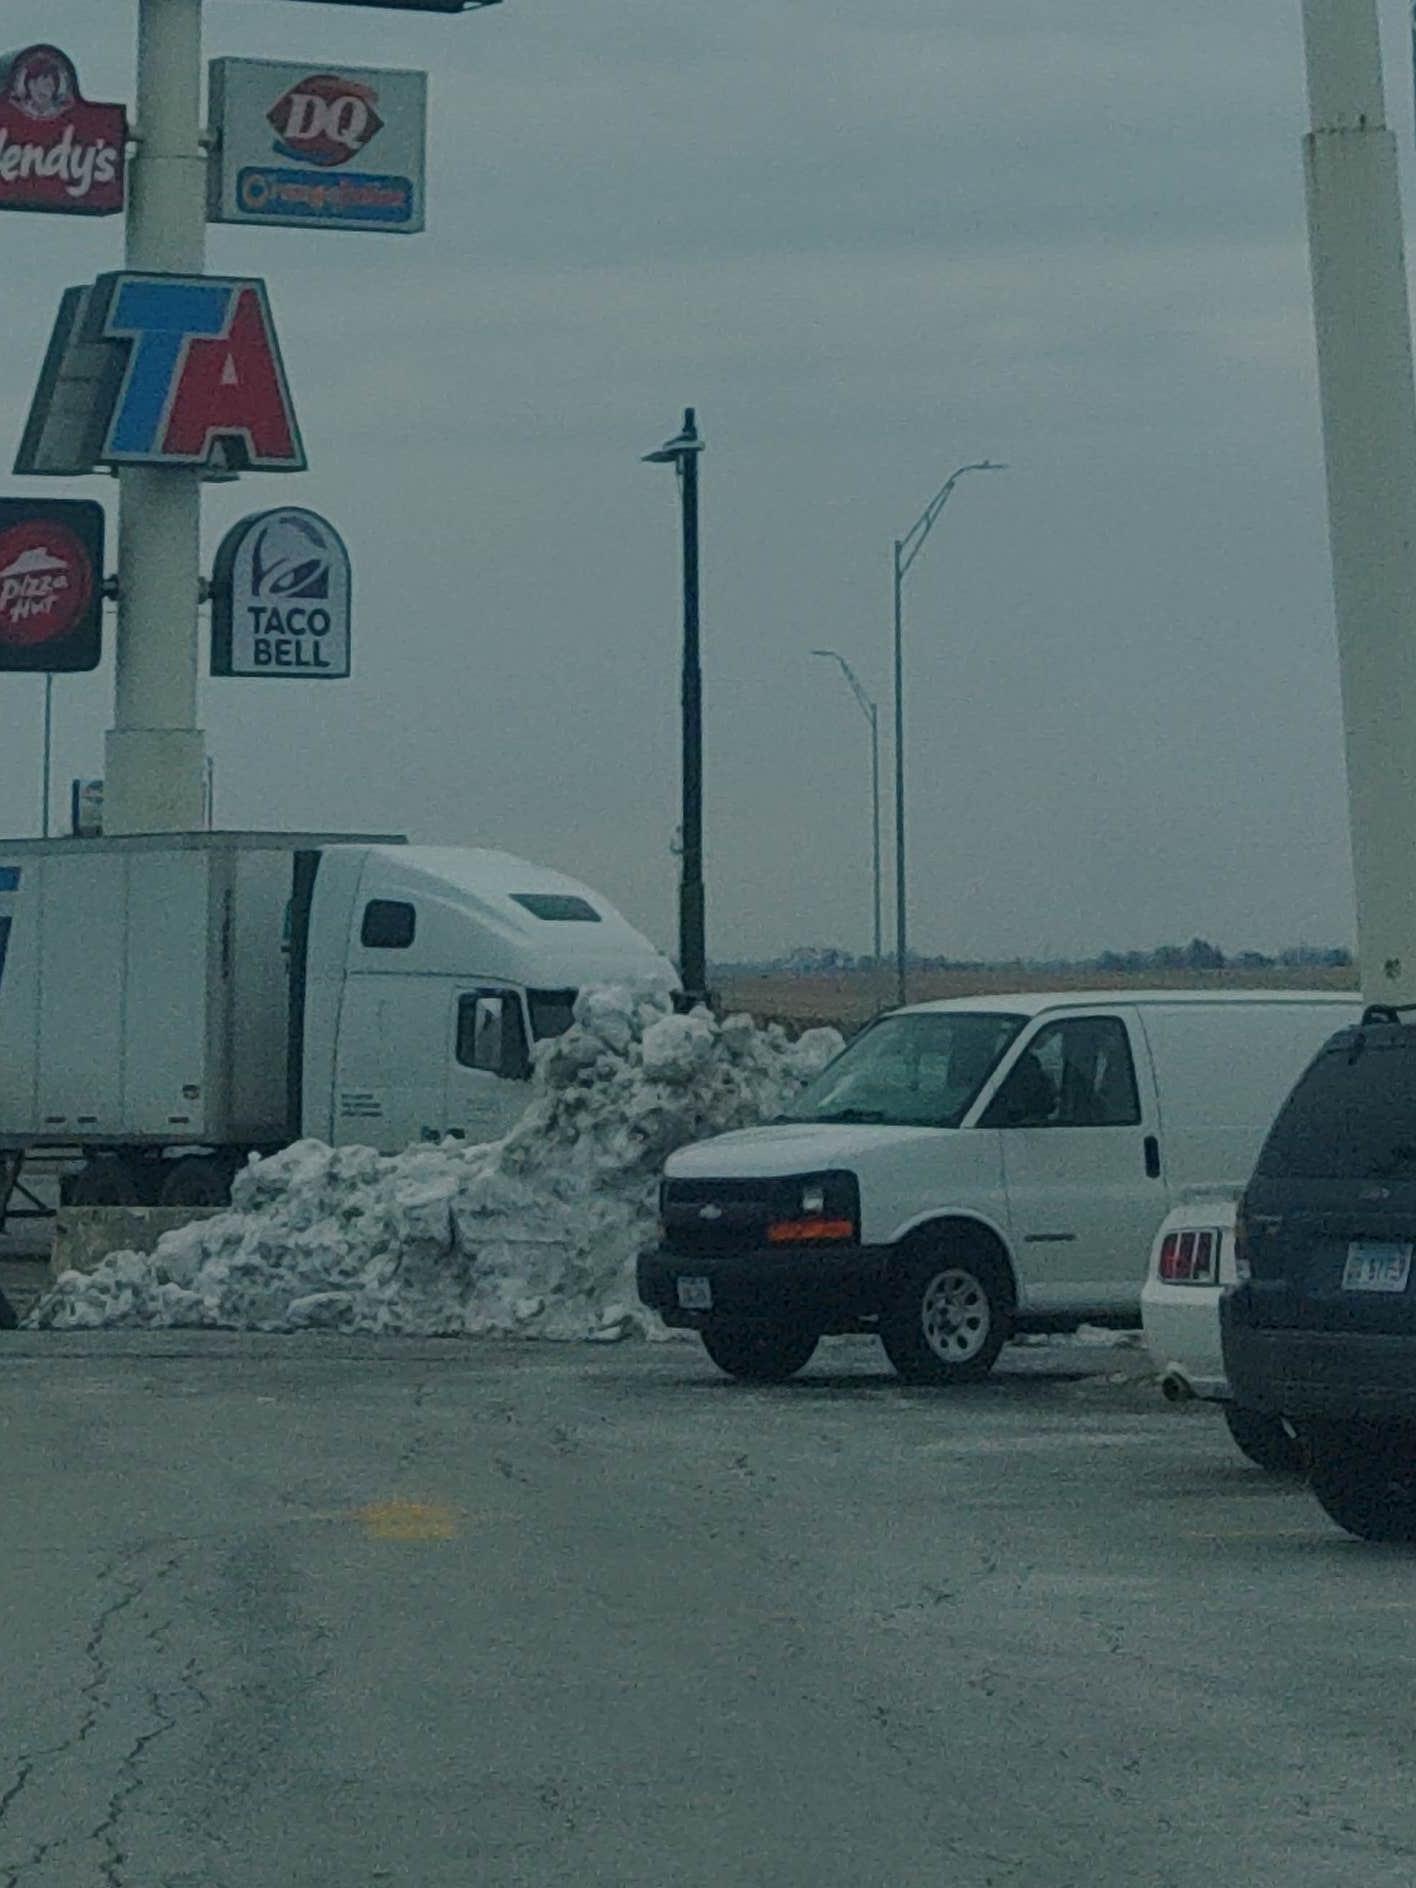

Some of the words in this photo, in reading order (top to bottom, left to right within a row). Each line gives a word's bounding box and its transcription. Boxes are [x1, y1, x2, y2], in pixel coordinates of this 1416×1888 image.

[284, 93, 369, 151] DQ
[102, 280, 300, 462] TA
[246, 605, 331, 638] TACO
[252, 638, 331, 669] BELL
